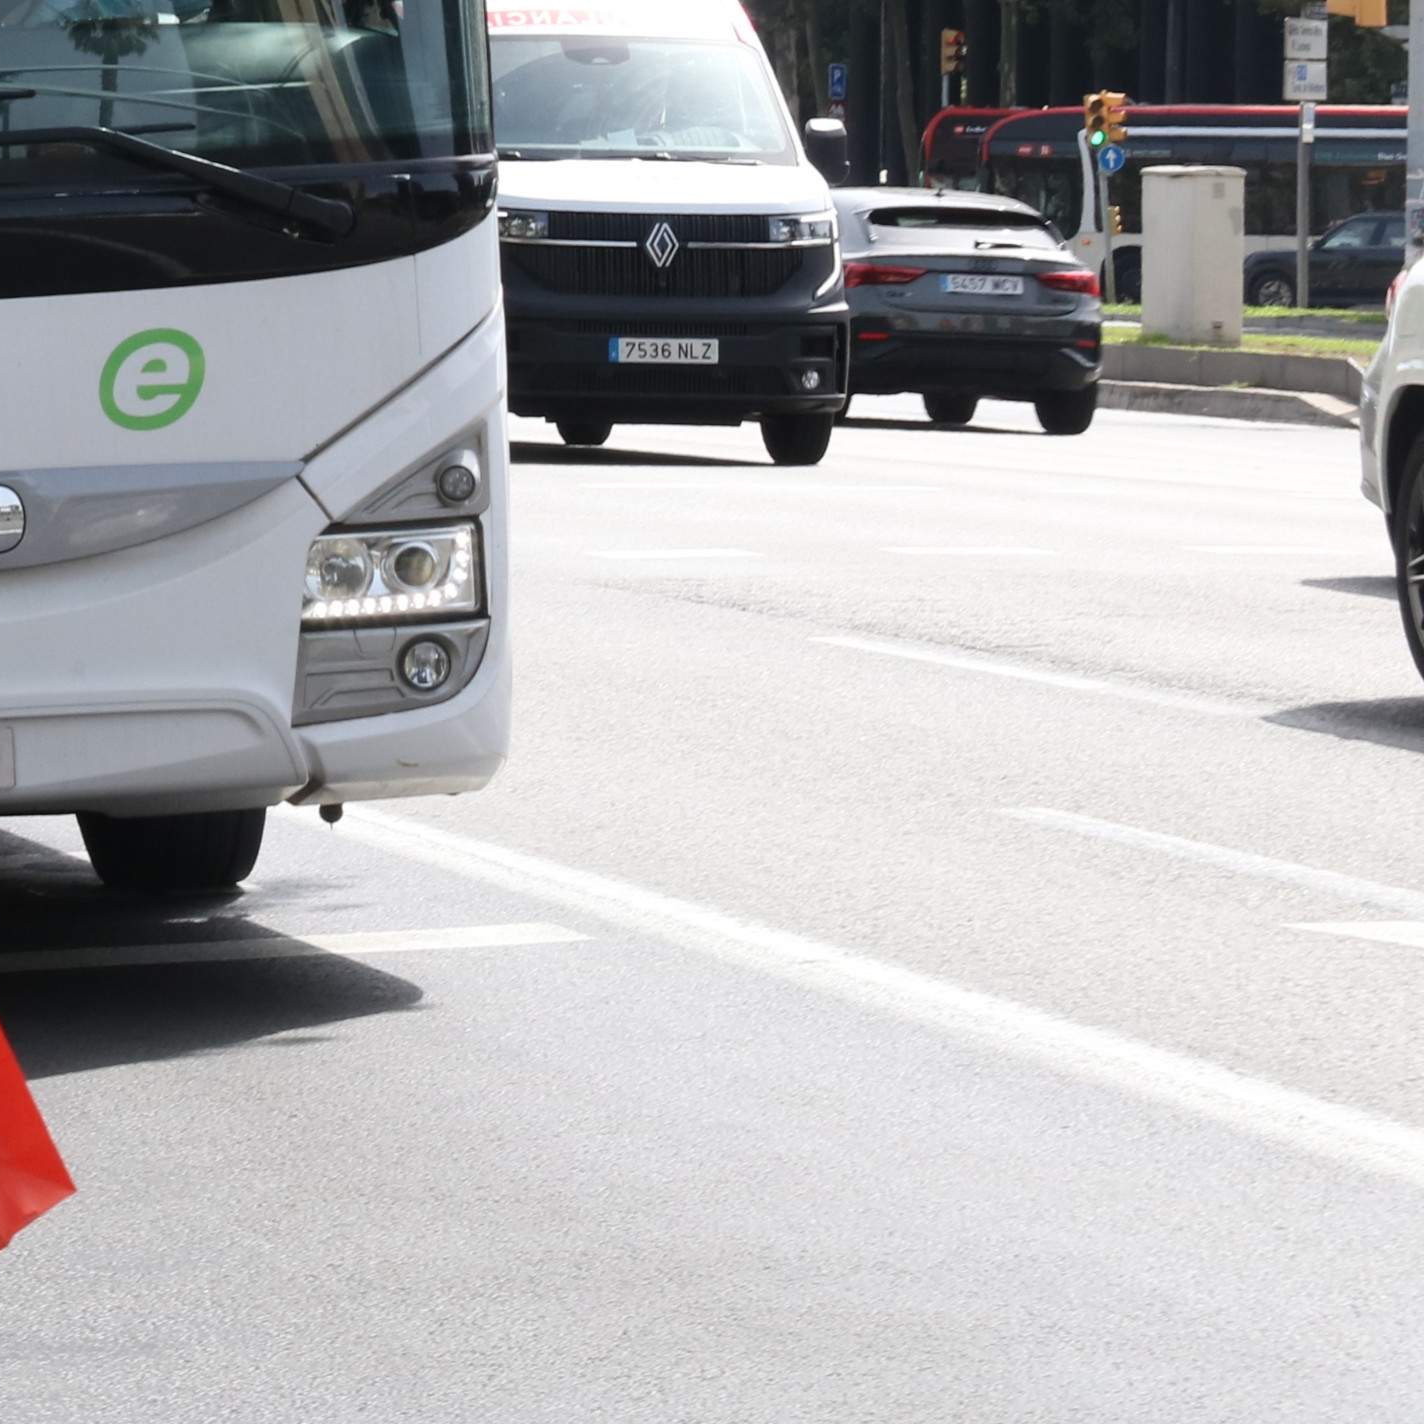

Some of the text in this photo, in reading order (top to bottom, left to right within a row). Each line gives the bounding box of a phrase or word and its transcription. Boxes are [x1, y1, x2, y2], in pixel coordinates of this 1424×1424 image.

[99, 328, 205, 431] e
[625, 341, 712, 360] 7536 NLZ
